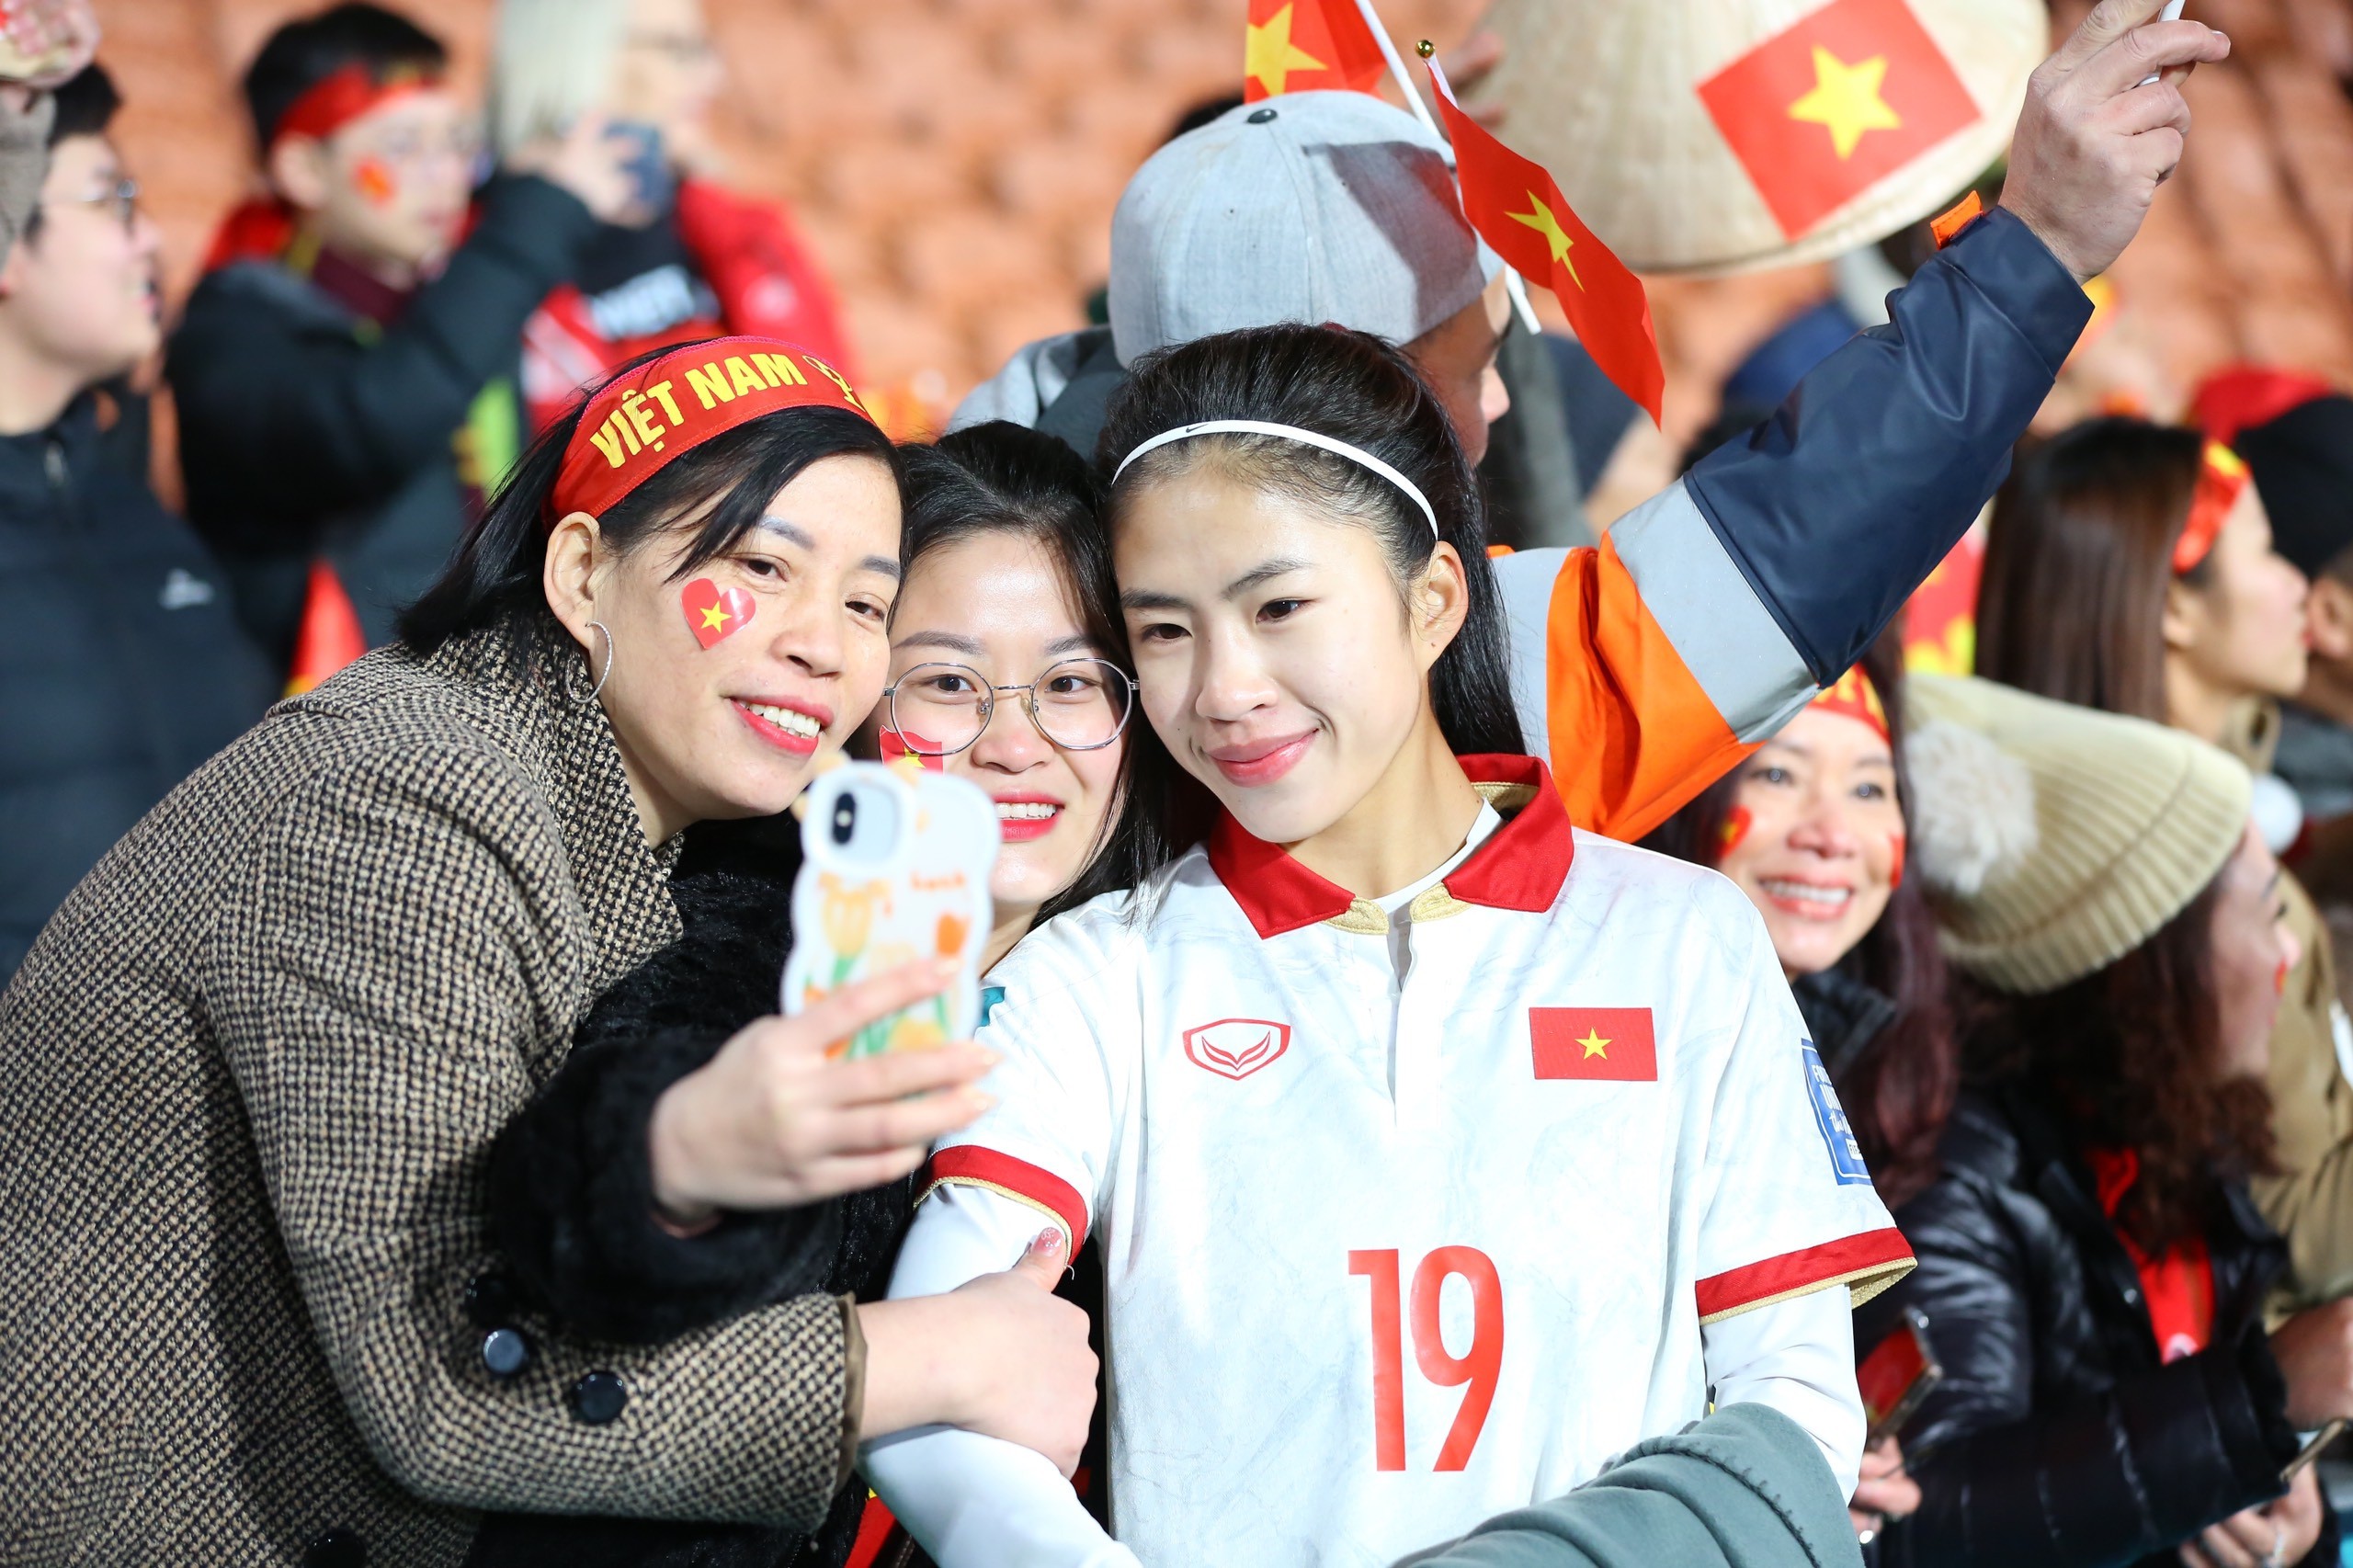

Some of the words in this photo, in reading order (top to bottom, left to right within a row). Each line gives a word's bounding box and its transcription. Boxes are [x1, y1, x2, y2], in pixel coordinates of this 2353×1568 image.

[589, 379, 685, 469] VIỆT
[684, 353, 808, 410] NAM
[1347, 1245, 1505, 1472] 19
